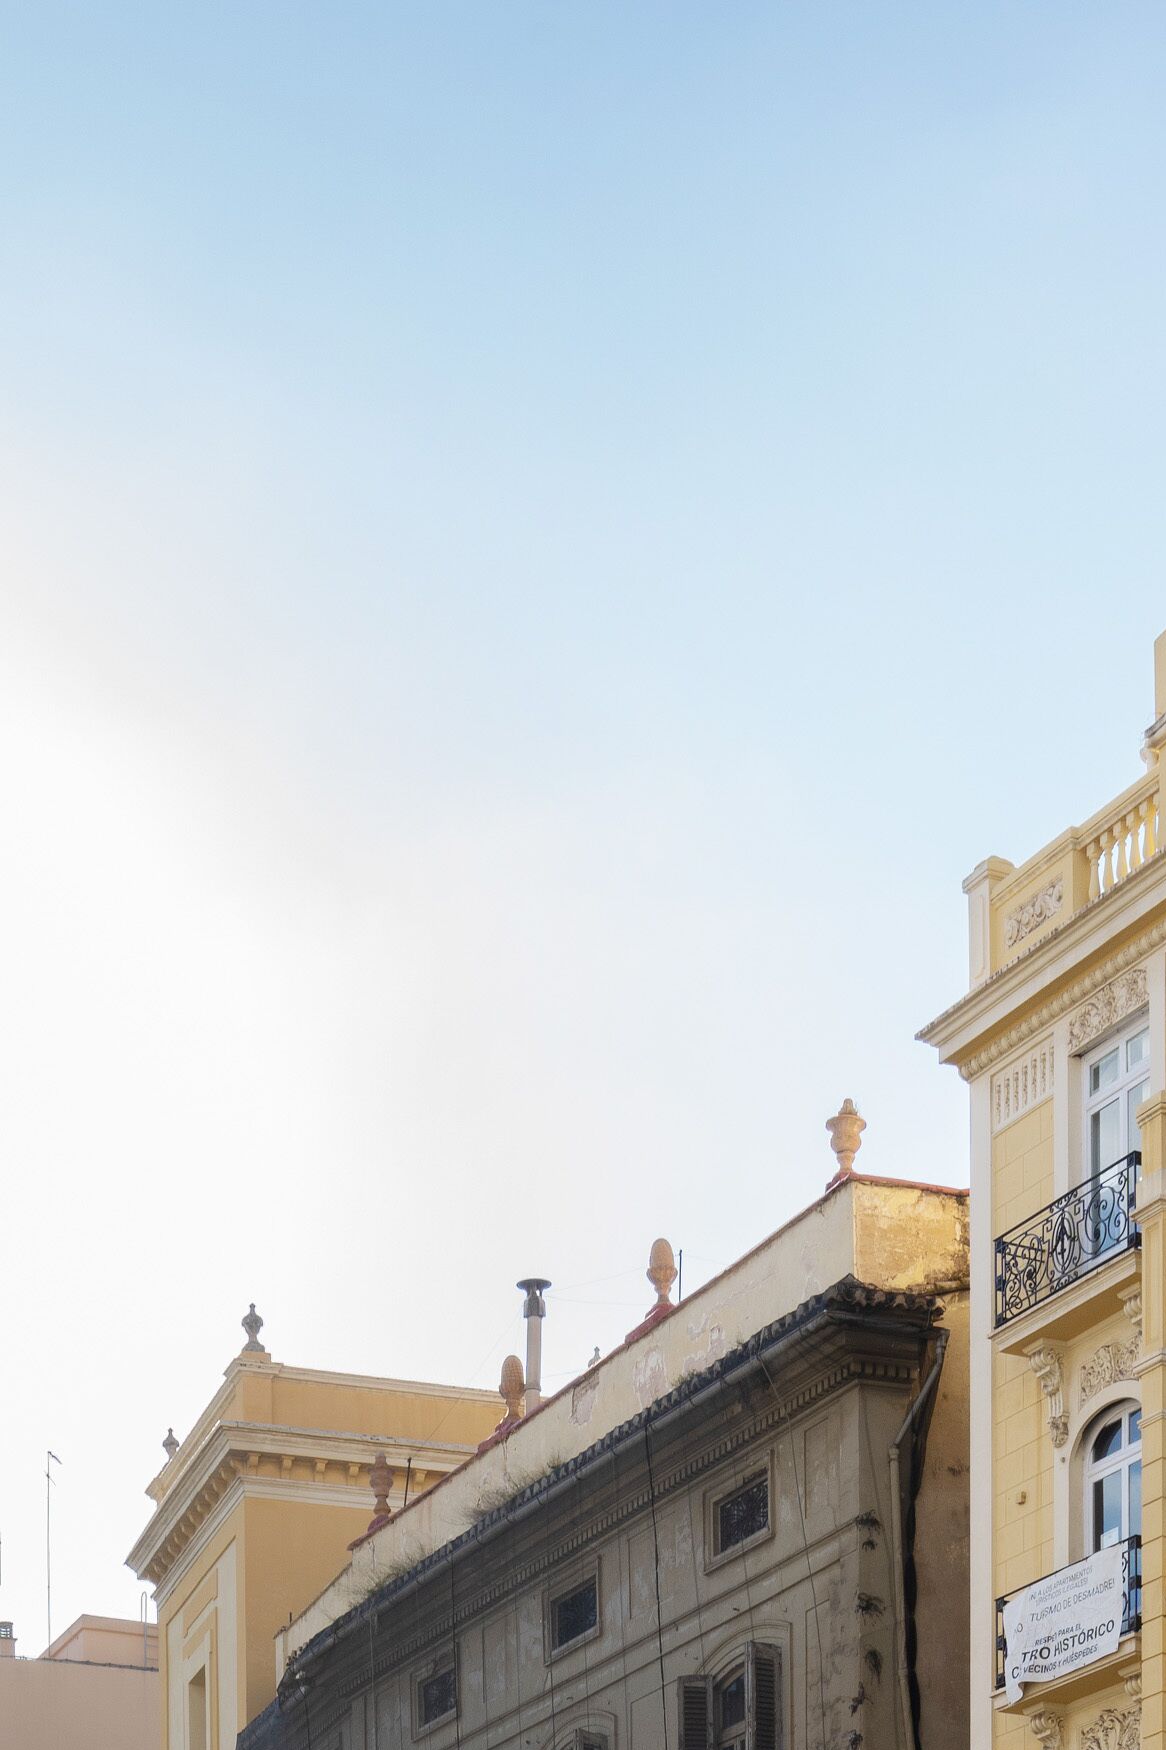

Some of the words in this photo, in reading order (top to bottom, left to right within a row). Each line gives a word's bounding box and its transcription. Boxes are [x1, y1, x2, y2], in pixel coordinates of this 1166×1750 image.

[1062, 1597, 1072, 1610] DE
[1058, 1626, 1074, 1637] PARA
[1074, 1623, 1083, 1632] EL
[1053, 1619, 1116, 1657] HISTÓRICO
[1023, 1660, 1057, 1674] VECINOS
